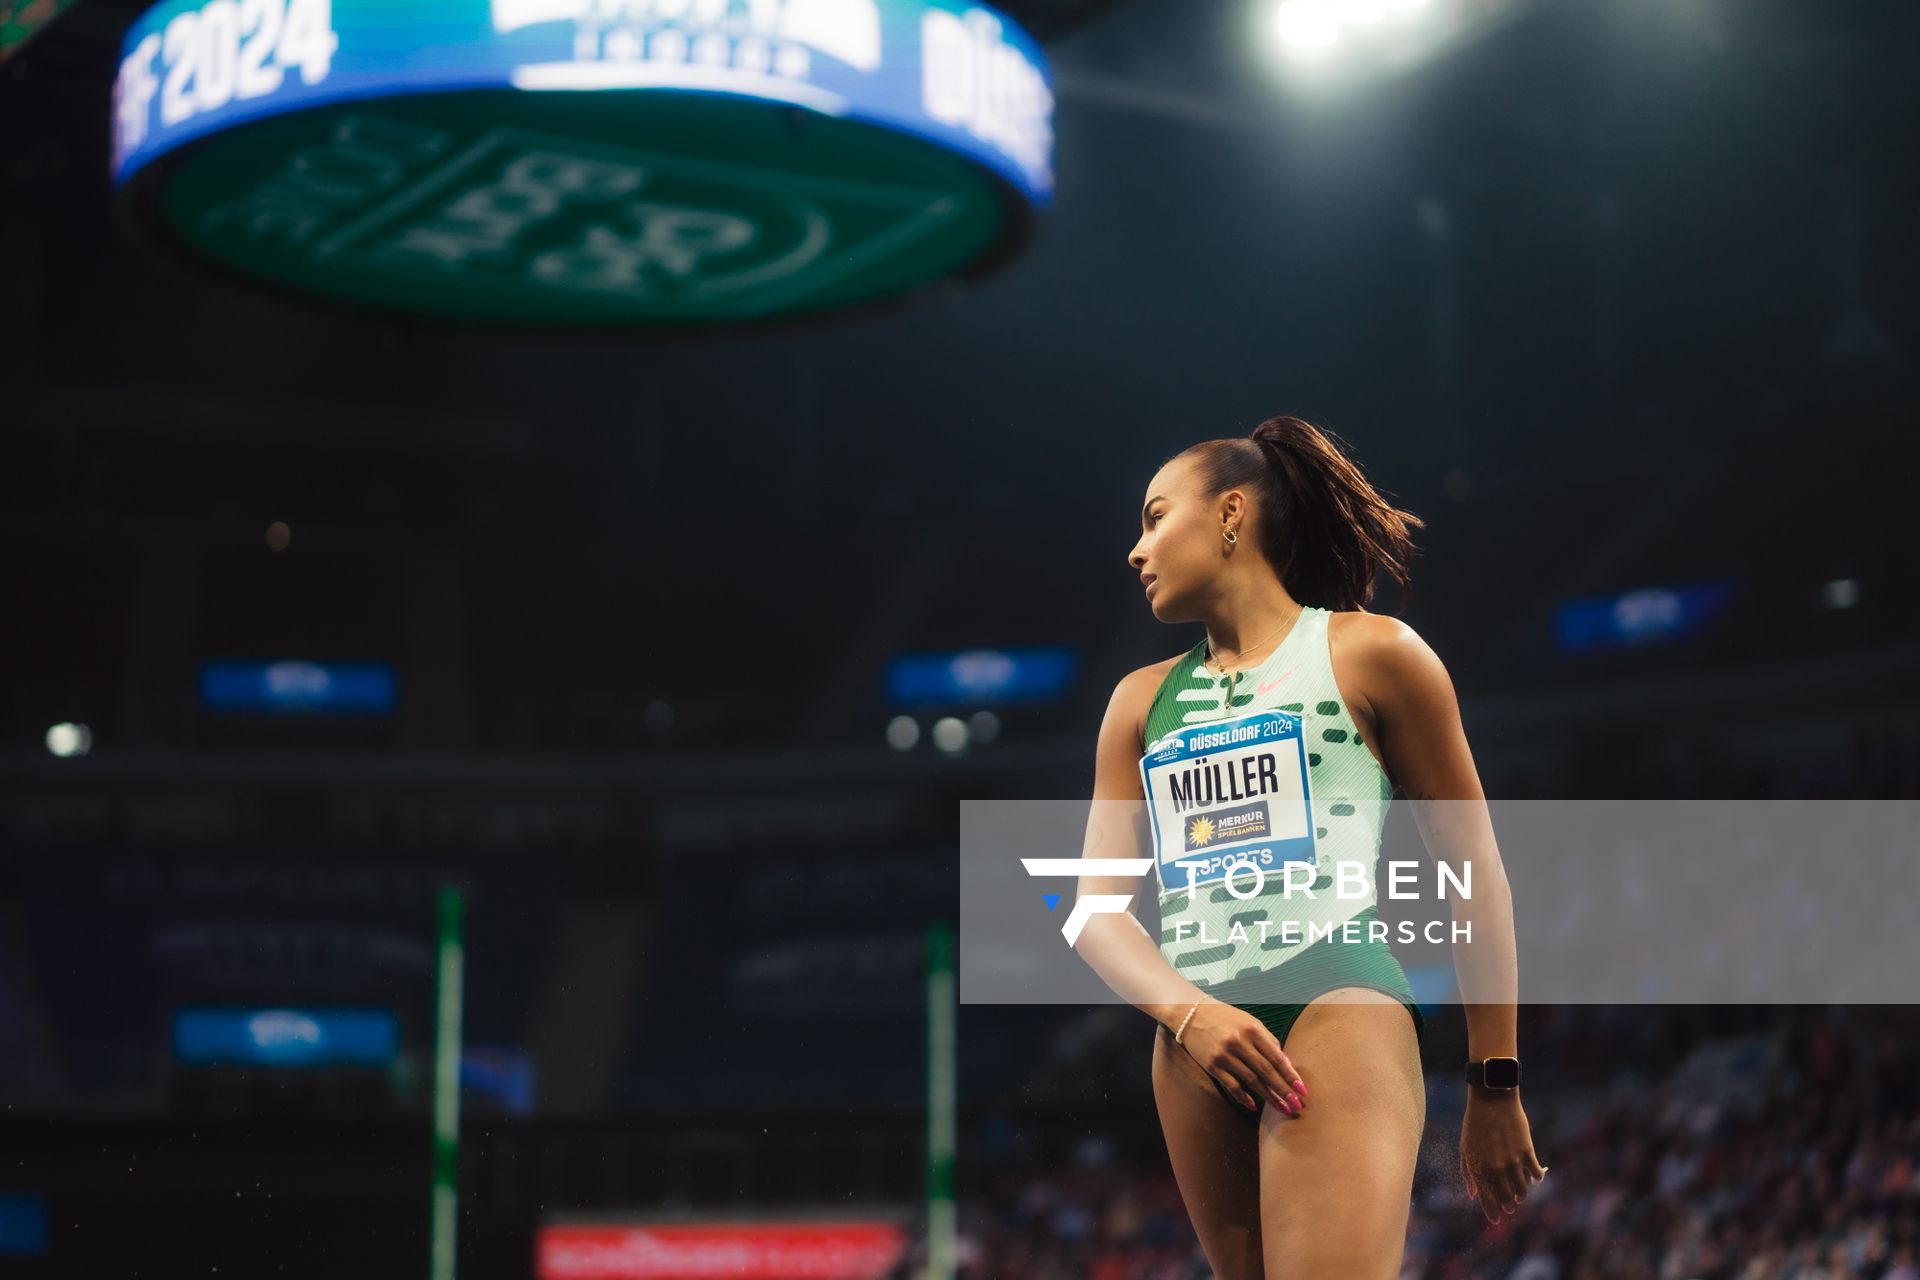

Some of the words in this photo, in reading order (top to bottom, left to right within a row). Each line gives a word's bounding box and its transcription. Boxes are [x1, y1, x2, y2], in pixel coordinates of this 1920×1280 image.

[162, 0, 338, 127] 2024
[1190, 724, 1261, 752] DÜSSELDORF
[1264, 719, 1293, 736] 2024
[1169, 753, 1278, 814] MÜLLER
[1217, 824, 1266, 839] SPIELBANKEN
[1218, 811, 1264, 828] MERKUR
